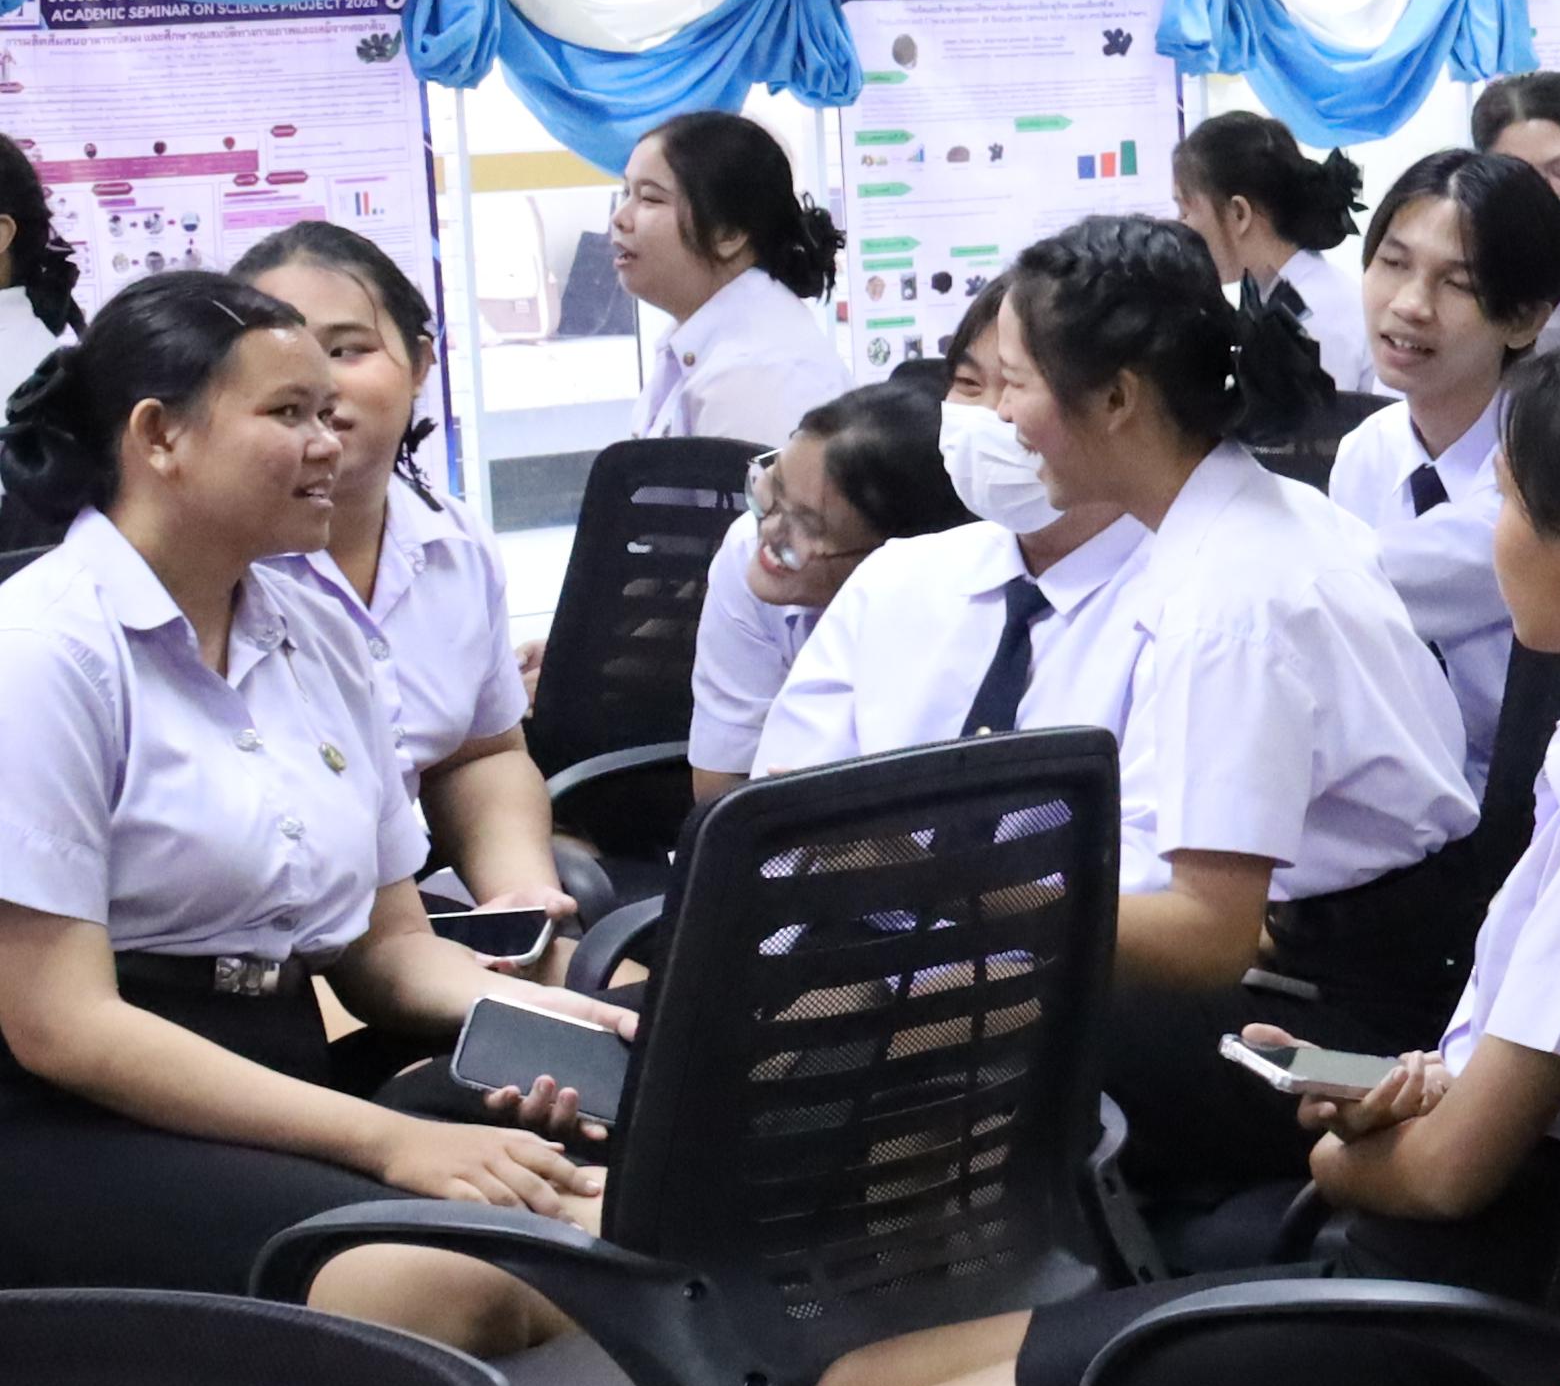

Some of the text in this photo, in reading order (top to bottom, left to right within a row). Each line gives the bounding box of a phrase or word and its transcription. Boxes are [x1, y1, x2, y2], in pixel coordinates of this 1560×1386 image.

[51, 7, 126, 23] ACADEMIC
[127, 3, 191, 20] SEMINAR
[192, 2, 216, 16] ON
